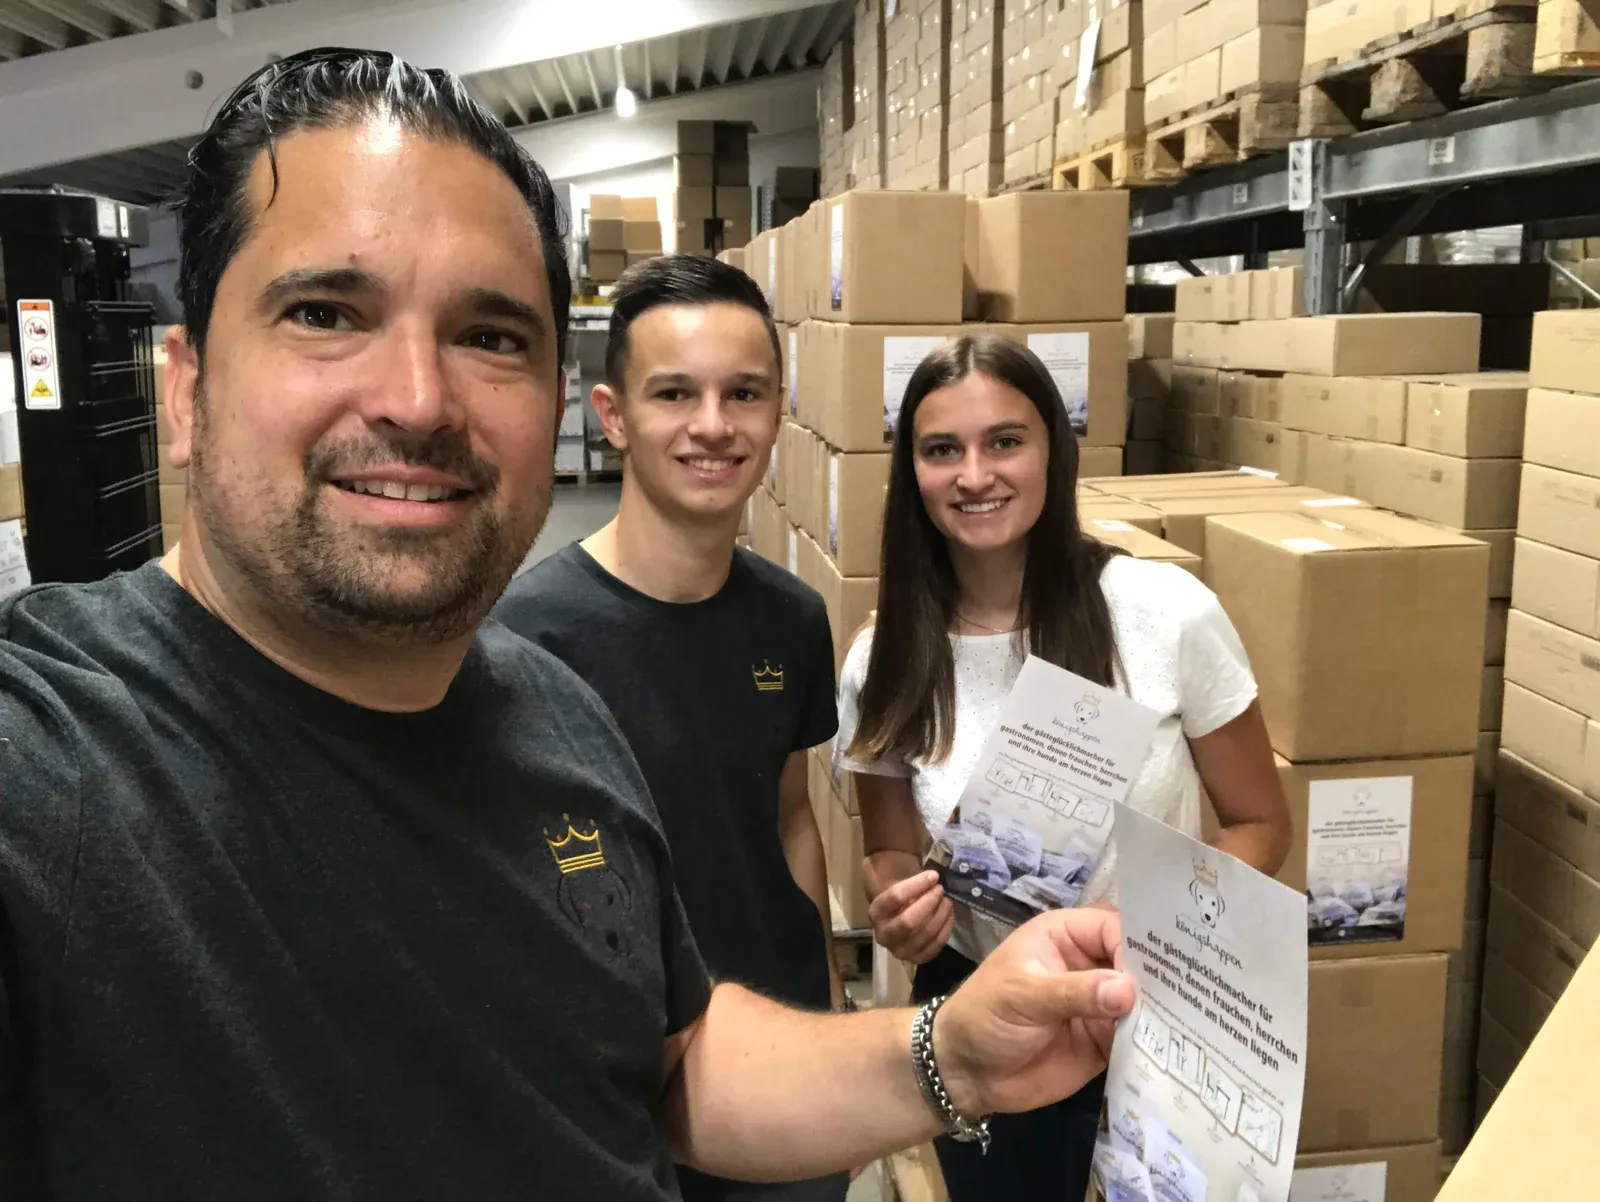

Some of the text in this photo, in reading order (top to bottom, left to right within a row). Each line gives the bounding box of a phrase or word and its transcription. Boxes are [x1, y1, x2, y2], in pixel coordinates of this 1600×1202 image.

[1008, 738, 1022, 749] und
[1022, 743, 1036, 755] ihre
[1036, 748, 1058, 764] hunde
[1058, 759, 1069, 768] am
[1069, 764, 1092, 780] herzen
[1092, 774, 1113, 788] liegen
[1022, 720, 1035, 733] der
[1105, 758, 1116, 768] für
[1046, 744, 1068, 758] denen
[1099, 766, 1128, 784] herrchen
[1126, 936, 1184, 981] gastronomen,
[1185, 972, 1211, 1000] denen
[1213, 990, 1253, 1032] frauchen,
[1256, 1022, 1298, 1065] herrchen
[1147, 930, 1162, 947] der
[1163, 942, 1257, 1013] gästeglücklichmacher
[1259, 1003, 1274, 1025] für
[1143, 961, 1159, 980] und
[1160, 971, 1177, 992] ihre
[1177, 983, 1203, 1013] hunde
[1204, 1008, 1218, 1025] am
[1219, 1013, 1249, 1049] herzen
[1250, 1038, 1280, 1072] liegen
